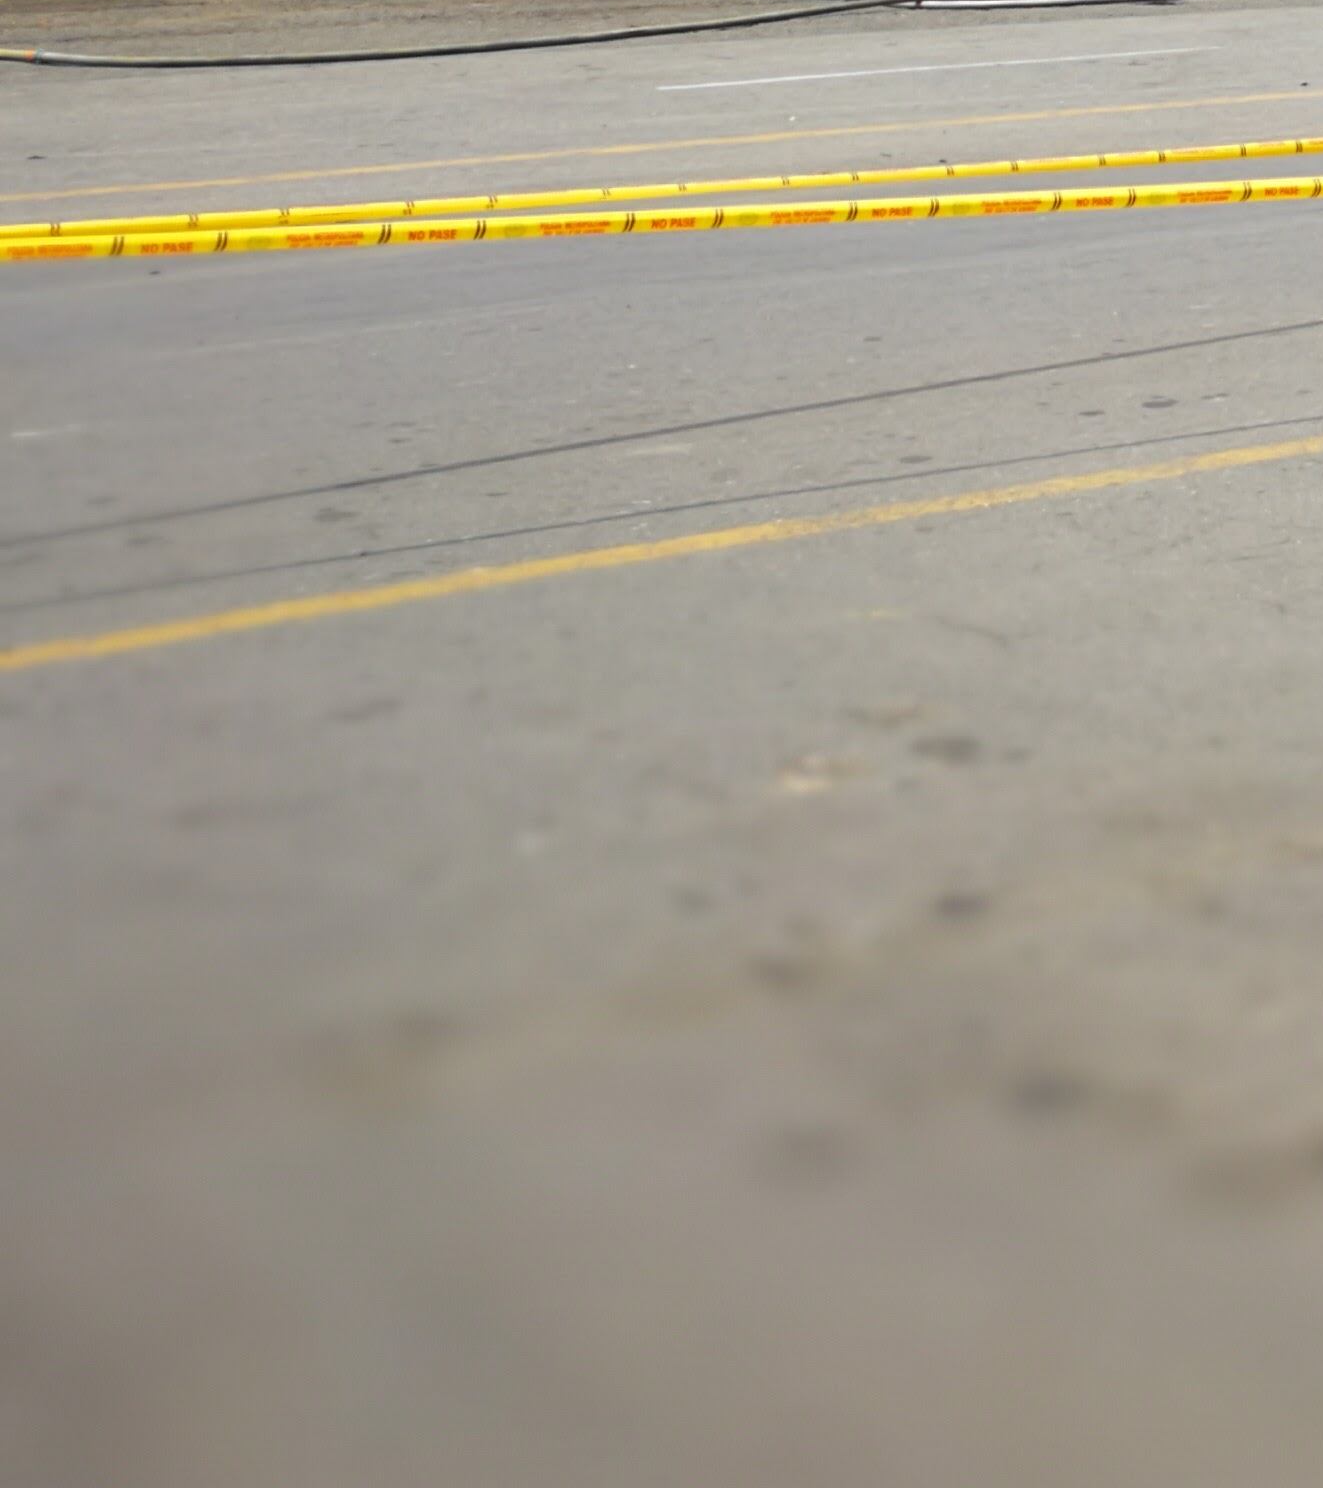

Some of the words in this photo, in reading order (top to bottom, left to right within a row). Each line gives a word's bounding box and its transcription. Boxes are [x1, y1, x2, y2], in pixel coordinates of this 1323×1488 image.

[651, 218, 667, 229] NO
[669, 216, 696, 228] PASE
[408, 230, 426, 241] NO
[429, 229, 457, 240] PASE
[141, 243, 160, 254] NO
[163, 242, 194, 253] PASE
